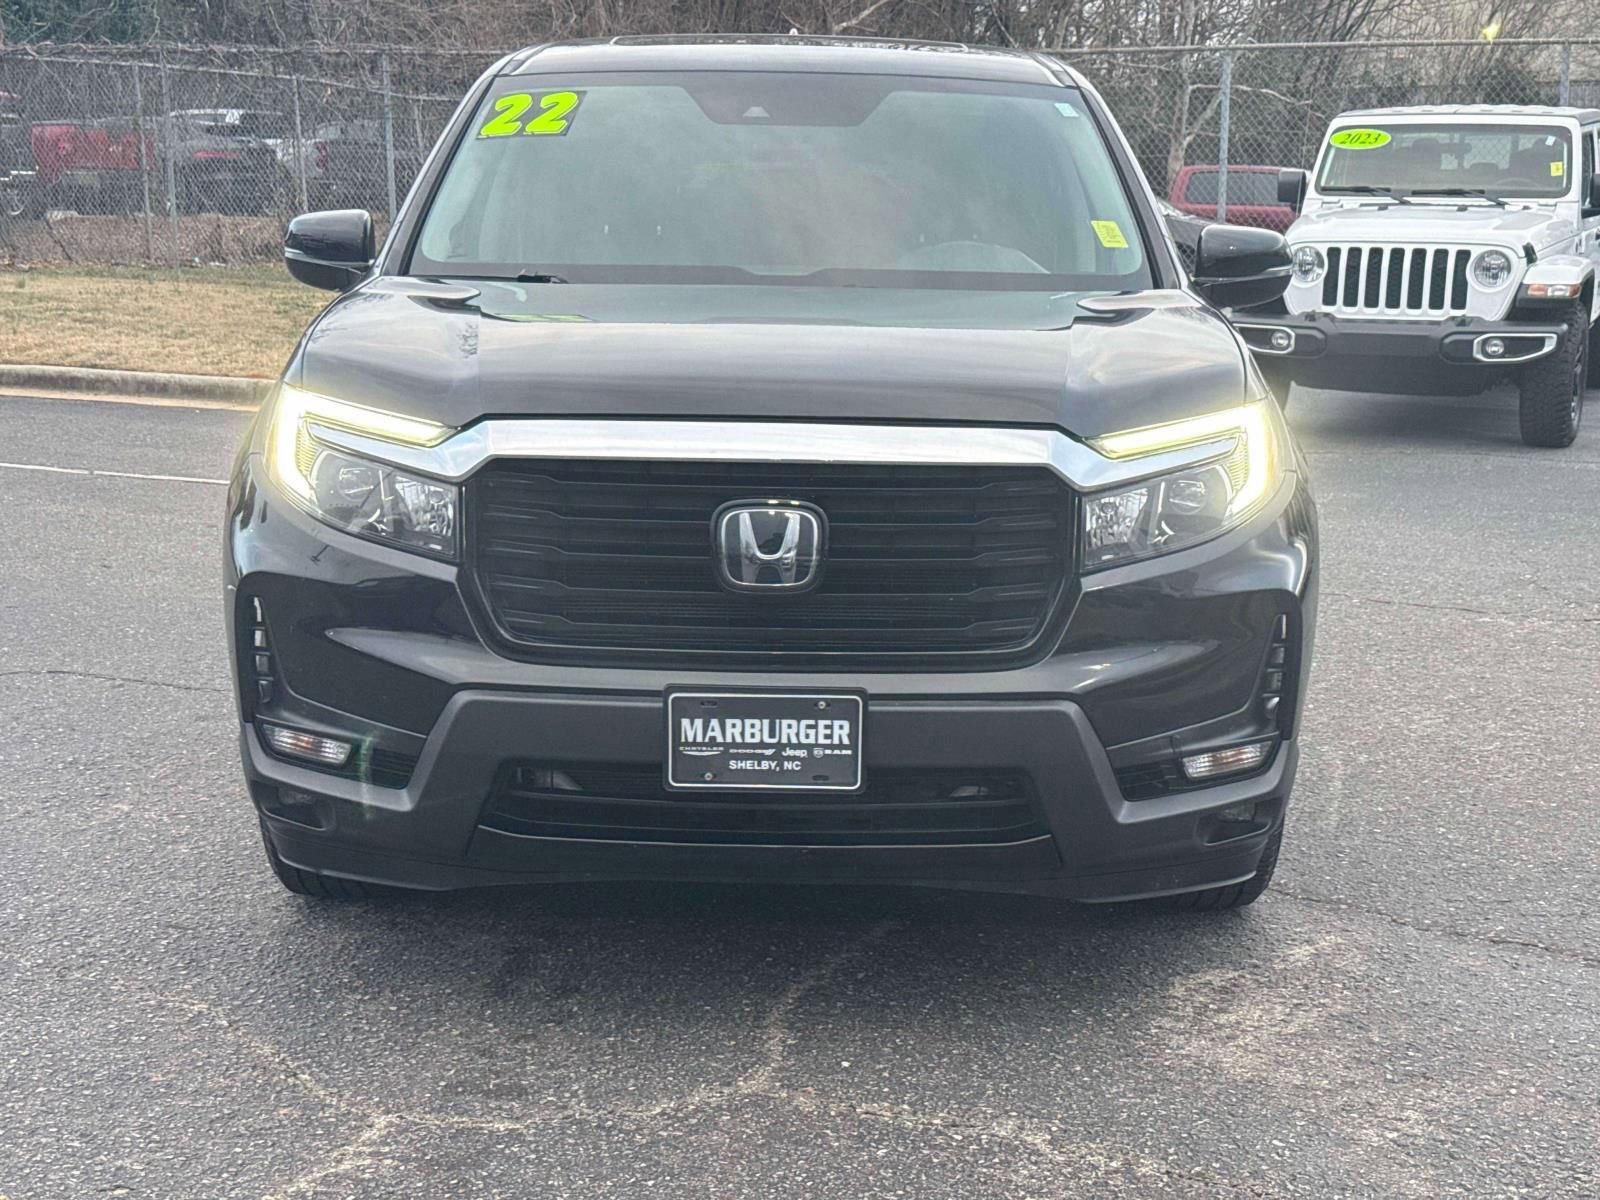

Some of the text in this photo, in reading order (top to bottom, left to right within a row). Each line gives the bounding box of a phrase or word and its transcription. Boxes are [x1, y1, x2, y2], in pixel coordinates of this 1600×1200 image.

[478, 91, 579, 138] 22
[1339, 133, 1382, 145] 2023
[680, 718, 850, 744] MARBURGER
[781, 747, 807, 758] Jeep
[729, 760, 802, 772] SHELBY, NC
